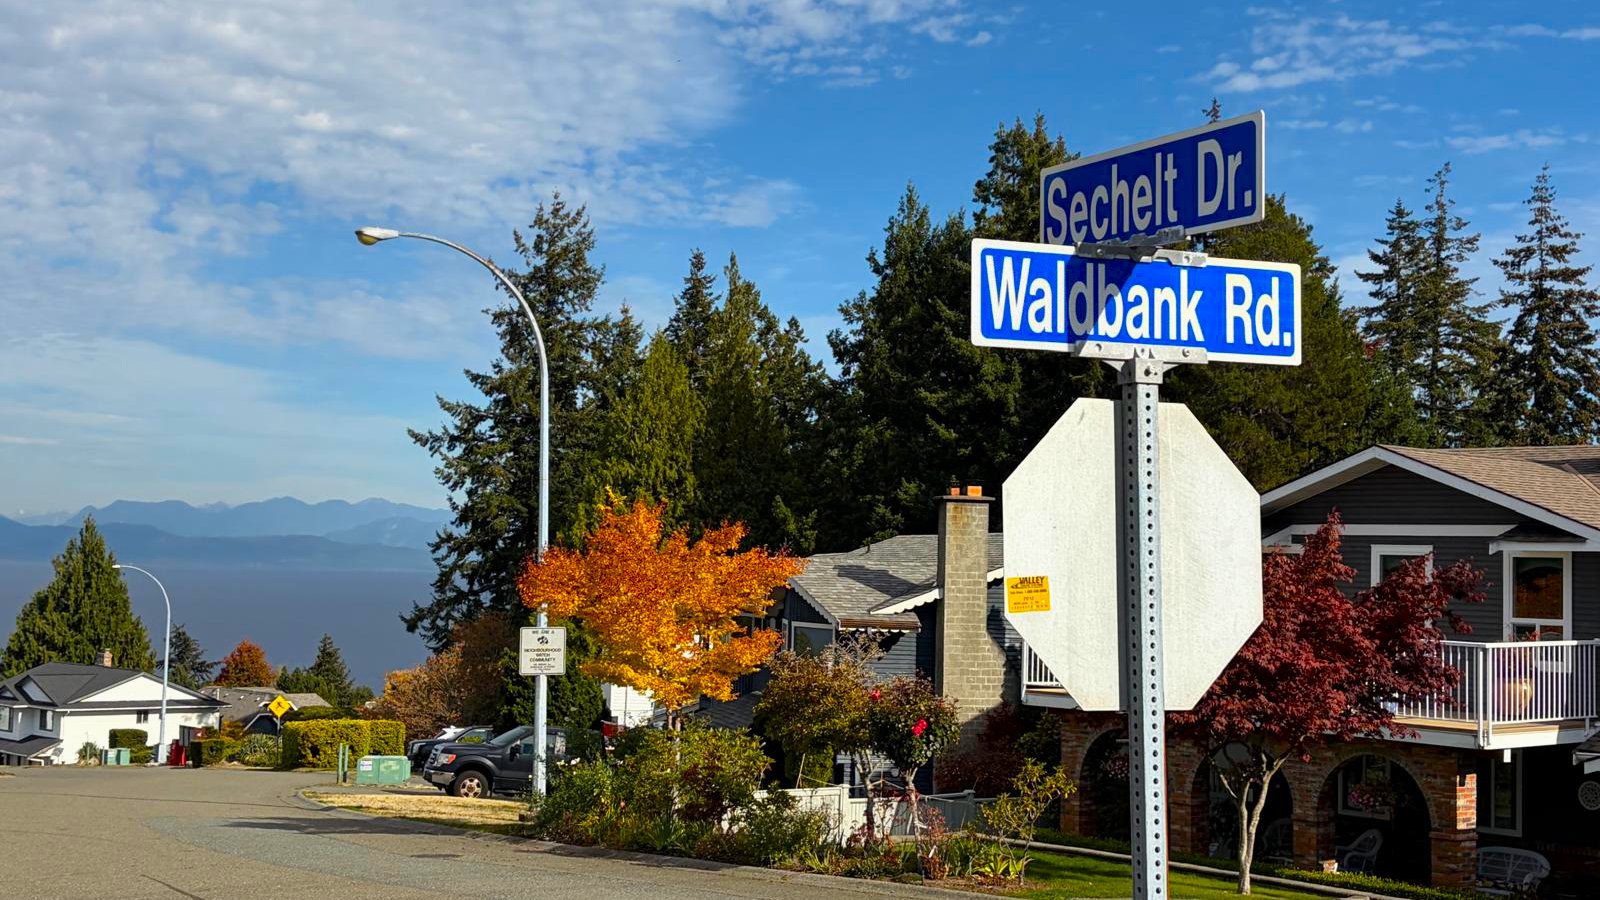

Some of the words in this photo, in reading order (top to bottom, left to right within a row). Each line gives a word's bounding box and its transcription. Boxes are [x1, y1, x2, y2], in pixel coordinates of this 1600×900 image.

[1046, 152, 1178, 244] Sechelt
[1197, 138, 1252, 217] Dr.
[985, 254, 1205, 342] Waldbank
[1225, 273, 1292, 347] Rd.
